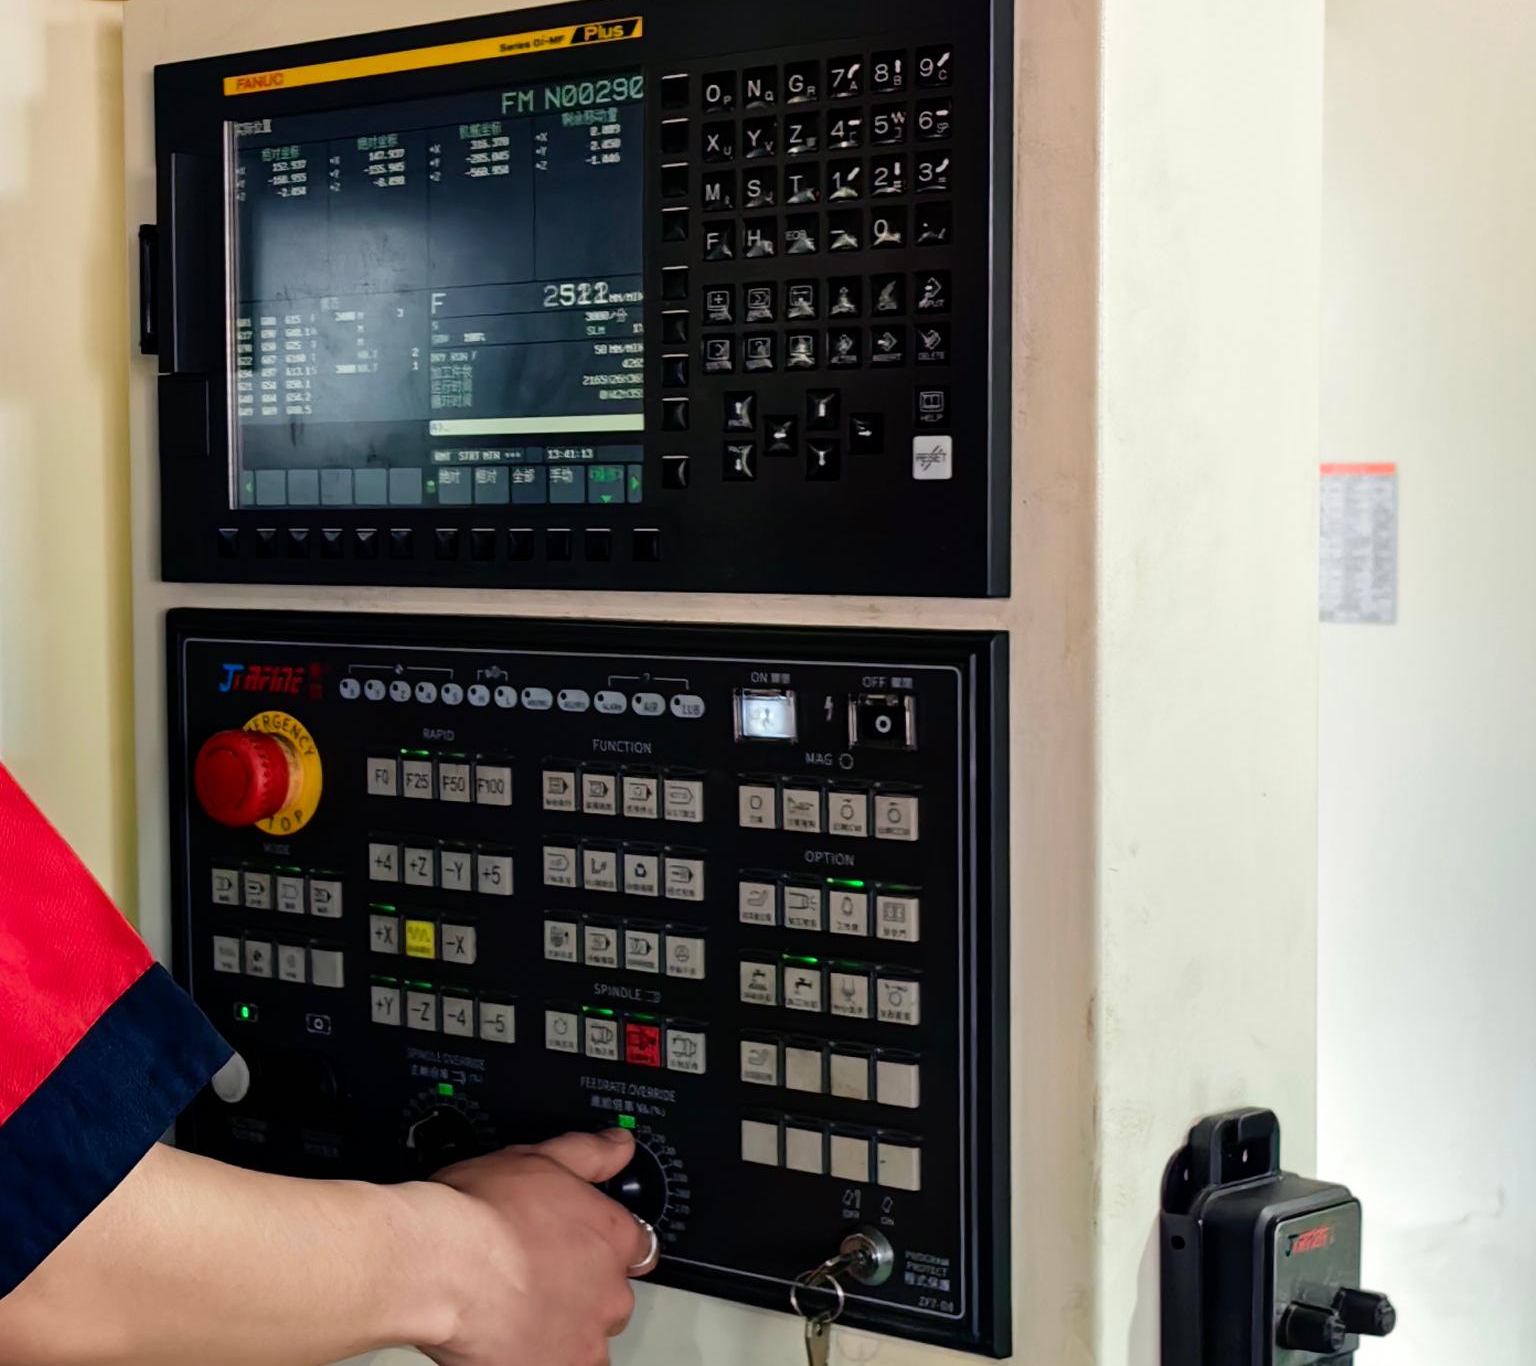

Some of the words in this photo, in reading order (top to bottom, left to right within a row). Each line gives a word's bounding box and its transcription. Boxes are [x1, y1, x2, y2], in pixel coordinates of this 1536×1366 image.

[584, 24, 624, 41] Plus
[874, 63, 889, 82] 8
[919, 58, 934, 77] 9
[235, 72, 284, 91] FANUC
[788, 74, 804, 92] G
[831, 68, 845, 87] 7
[501, 89, 535, 114] FM
[544, 75, 644, 110] N00290
[706, 84, 721, 102] O
[747, 79, 761, 98] N
[874, 115, 889, 134] 5
[919, 110, 933, 129] 6
[747, 129, 762, 147] Y
[789, 124, 803, 143] Z
[830, 120, 845, 138] 4
[707, 134, 720, 152] X
[832, 171, 841, 190] 1
[874, 167, 888, 186] 2
[918, 163, 933, 181] 3
[705, 183, 720, 201] M
[747, 179, 761, 197] S
[788, 175, 803, 194] T
[706, 232, 720, 250] F
[747, 229, 761, 246] H
[431, 293, 447, 315] F
[750, 671, 768, 684] ON
[862, 676, 887, 689] OFF
[250, 714, 315, 757] ERGENCY
[422, 728, 455, 742] RAPID
[592, 738, 652, 754] FUNCTION
[805, 752, 833, 766] MAG
[375, 768, 390, 785] F0
[406, 772, 429, 790] F25
[442, 775, 465, 793] F50
[477, 778, 505, 795] F100
[267, 809, 303, 831] TOP
[374, 854, 392, 871] +4
[410, 855, 428, 877] +Z
[804, 850, 855, 867] OPTION
[483, 864, 502, 885] +5
[375, 924, 393, 945] +X
[593, 982, 642, 1001] SPINDLE
[375, 996, 394, 1016] +Y
[580, 1075, 627, 1095] FEEDRATE
[628, 1084, 676, 1102] OVERRIDE
